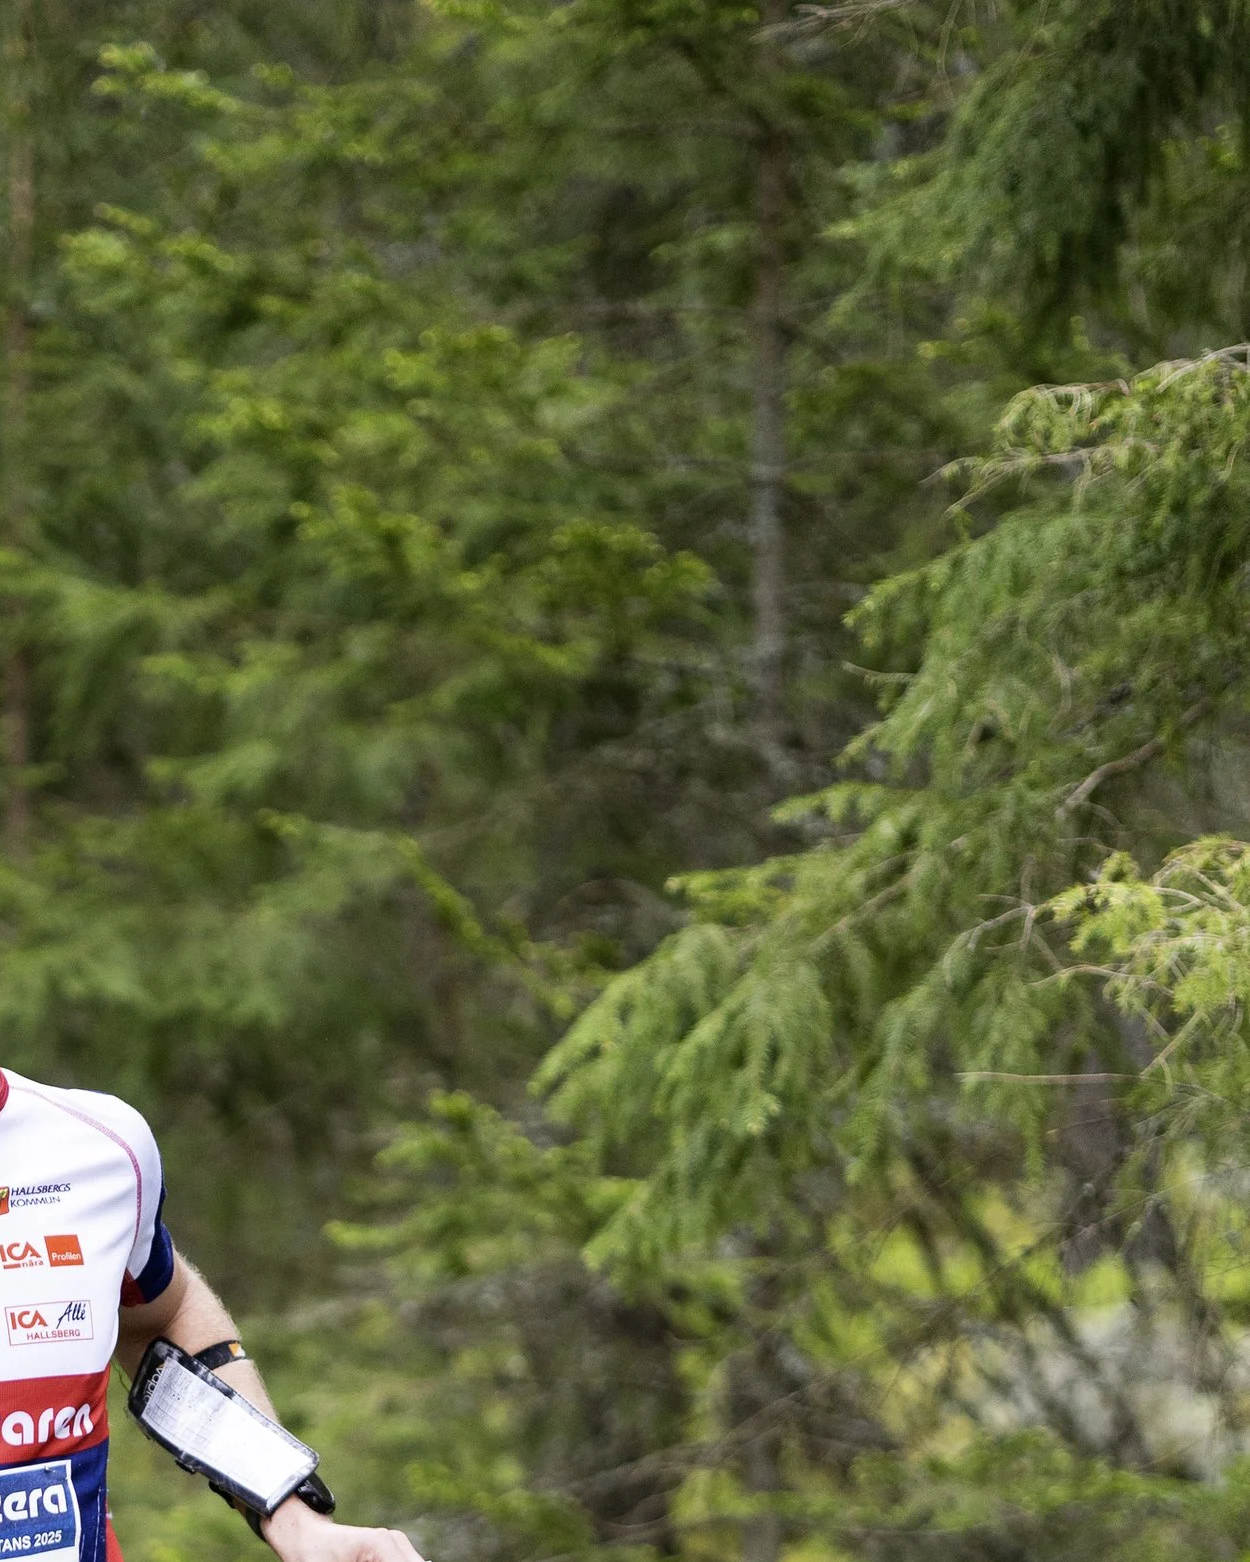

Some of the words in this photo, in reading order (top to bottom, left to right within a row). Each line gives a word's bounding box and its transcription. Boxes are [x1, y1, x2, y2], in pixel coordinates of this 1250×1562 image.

[10, 1182, 71, 1197] HALLSBERGS
[10, 1196, 61, 1208] KOMMUN
[9, 1309, 48, 1330] ICA
[26, 1328, 81, 1341] HALLSBERG
[33, 1529, 63, 1548] 2025
